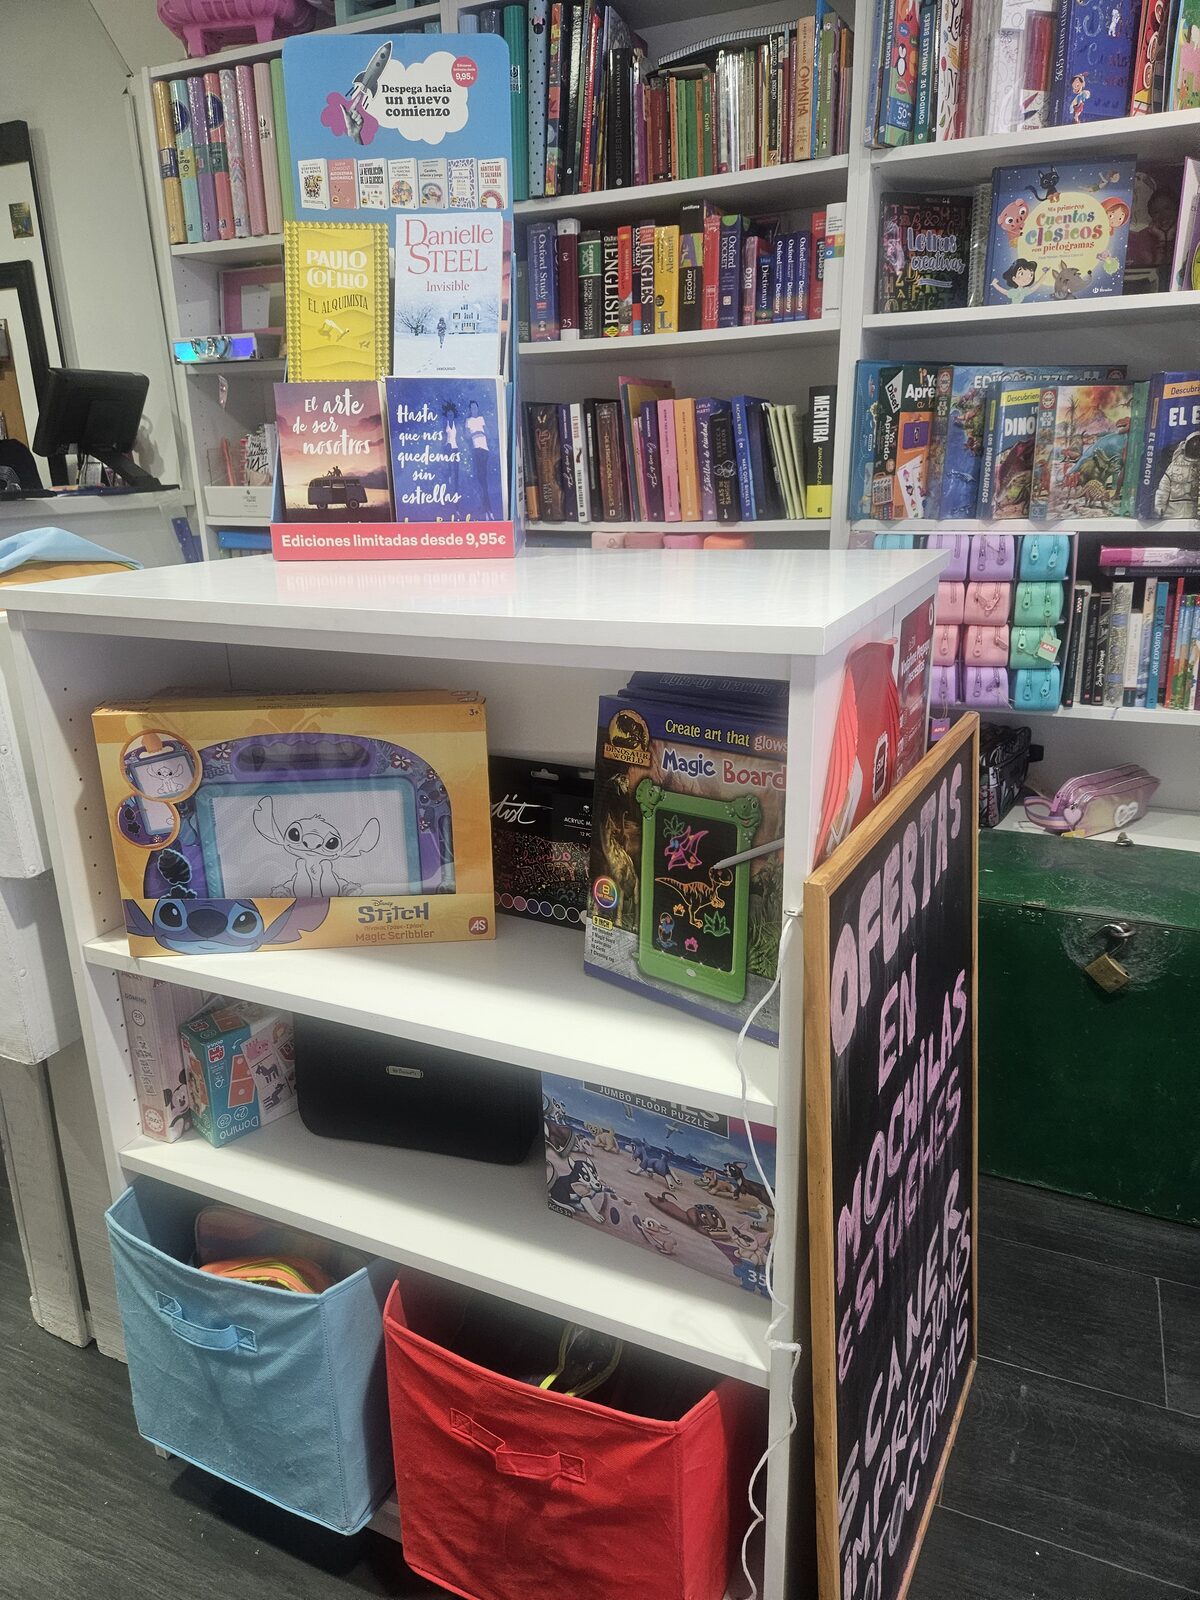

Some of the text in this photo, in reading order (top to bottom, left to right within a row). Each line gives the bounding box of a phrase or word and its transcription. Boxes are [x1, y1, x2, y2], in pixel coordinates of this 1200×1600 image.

[456, 72, 474, 80] 9,95€
[918, 12, 930, 124] SONIDOS DE ANIMALES BEBÉS
[1054, 58, 1064, 82] 365
[382, 85, 452, 95] Despega hacia
[385, 96, 450, 104] un nuevo
[798, 66, 810, 118] OMNIA
[386, 106, 450, 116] comienzo
[898, 108, 906, 119] 50
[369, 176, 384, 184] GLUCOSA
[1036, 210, 1095, 226] Cuentos
[1057, 204, 1084, 212] primeros
[404, 219, 494, 246] Danielle
[907, 227, 958, 253] Letras
[1025, 223, 1103, 246] clásicos
[408, 243, 488, 274] STEEL
[728, 236, 737, 268] Oxford
[1043, 242, 1095, 255] pictogramas
[306, 250, 367, 270] PAULO
[538, 234, 548, 300] Oxford Study
[912, 251, 966, 274] creativas
[306, 268, 368, 289] COELHO
[426, 280, 470, 292] Invisible
[604, 247, 619, 324] ENGLISH
[744, 268, 752, 289] DICO
[760, 265, 769, 309] Dictionary
[308, 294, 368, 314] EL ALQUIMISTA
[562, 318, 572, 328] 25
[304, 388, 364, 416] El arte
[887, 384, 899, 410] Diset
[292, 416, 338, 434] de ser
[396, 404, 438, 424] Hasta
[813, 395, 830, 443] MENTIRA
[1169, 407, 1187, 426] EL
[1004, 416, 1036, 436] DINO
[303, 429, 371, 456] nosotros
[399, 430, 444, 446] que nos
[883, 415, 892, 460] Aprendo
[398, 446, 461, 468] quedemos
[1144, 432, 1156, 486] EL ESPACIO
[412, 470, 436, 482] sin
[704, 458, 712, 495] Estrellas
[982, 448, 993, 503] DINOSAURIOS
[402, 484, 462, 505] estrellas
[282, 532, 506, 548] Ediciones limitadas desde 9,95€
[665, 720, 788, 752] Create art that glows
[605, 746, 649, 759] DINOSAUR
[613, 753, 644, 764] WORLD
[662, 749, 786, 789] Magic Board
[564, 817, 584, 825] ACRYLIC
[520, 862, 577, 886] PARTY
[358, 902, 429, 923] Stitch
[830, 762, 962, 1056] OFERTAS
[356, 930, 434, 942] Magic Scribbler
[470, 920, 486, 931] AS
[877, 952, 917, 1096] EN
[600, 1086, 632, 1102] JUMBO
[635, 1097, 667, 1115] FLOOR
[671, 1110, 710, 1129] PUZZLE
[219, 1115, 259, 1140] Domino
[837, 969, 967, 1296] MOCHILAS
[838, 1066, 961, 1382] ESTUCHES
[748, 1270, 767, 1286] 35
[838, 1168, 962, 1554] SCANER
